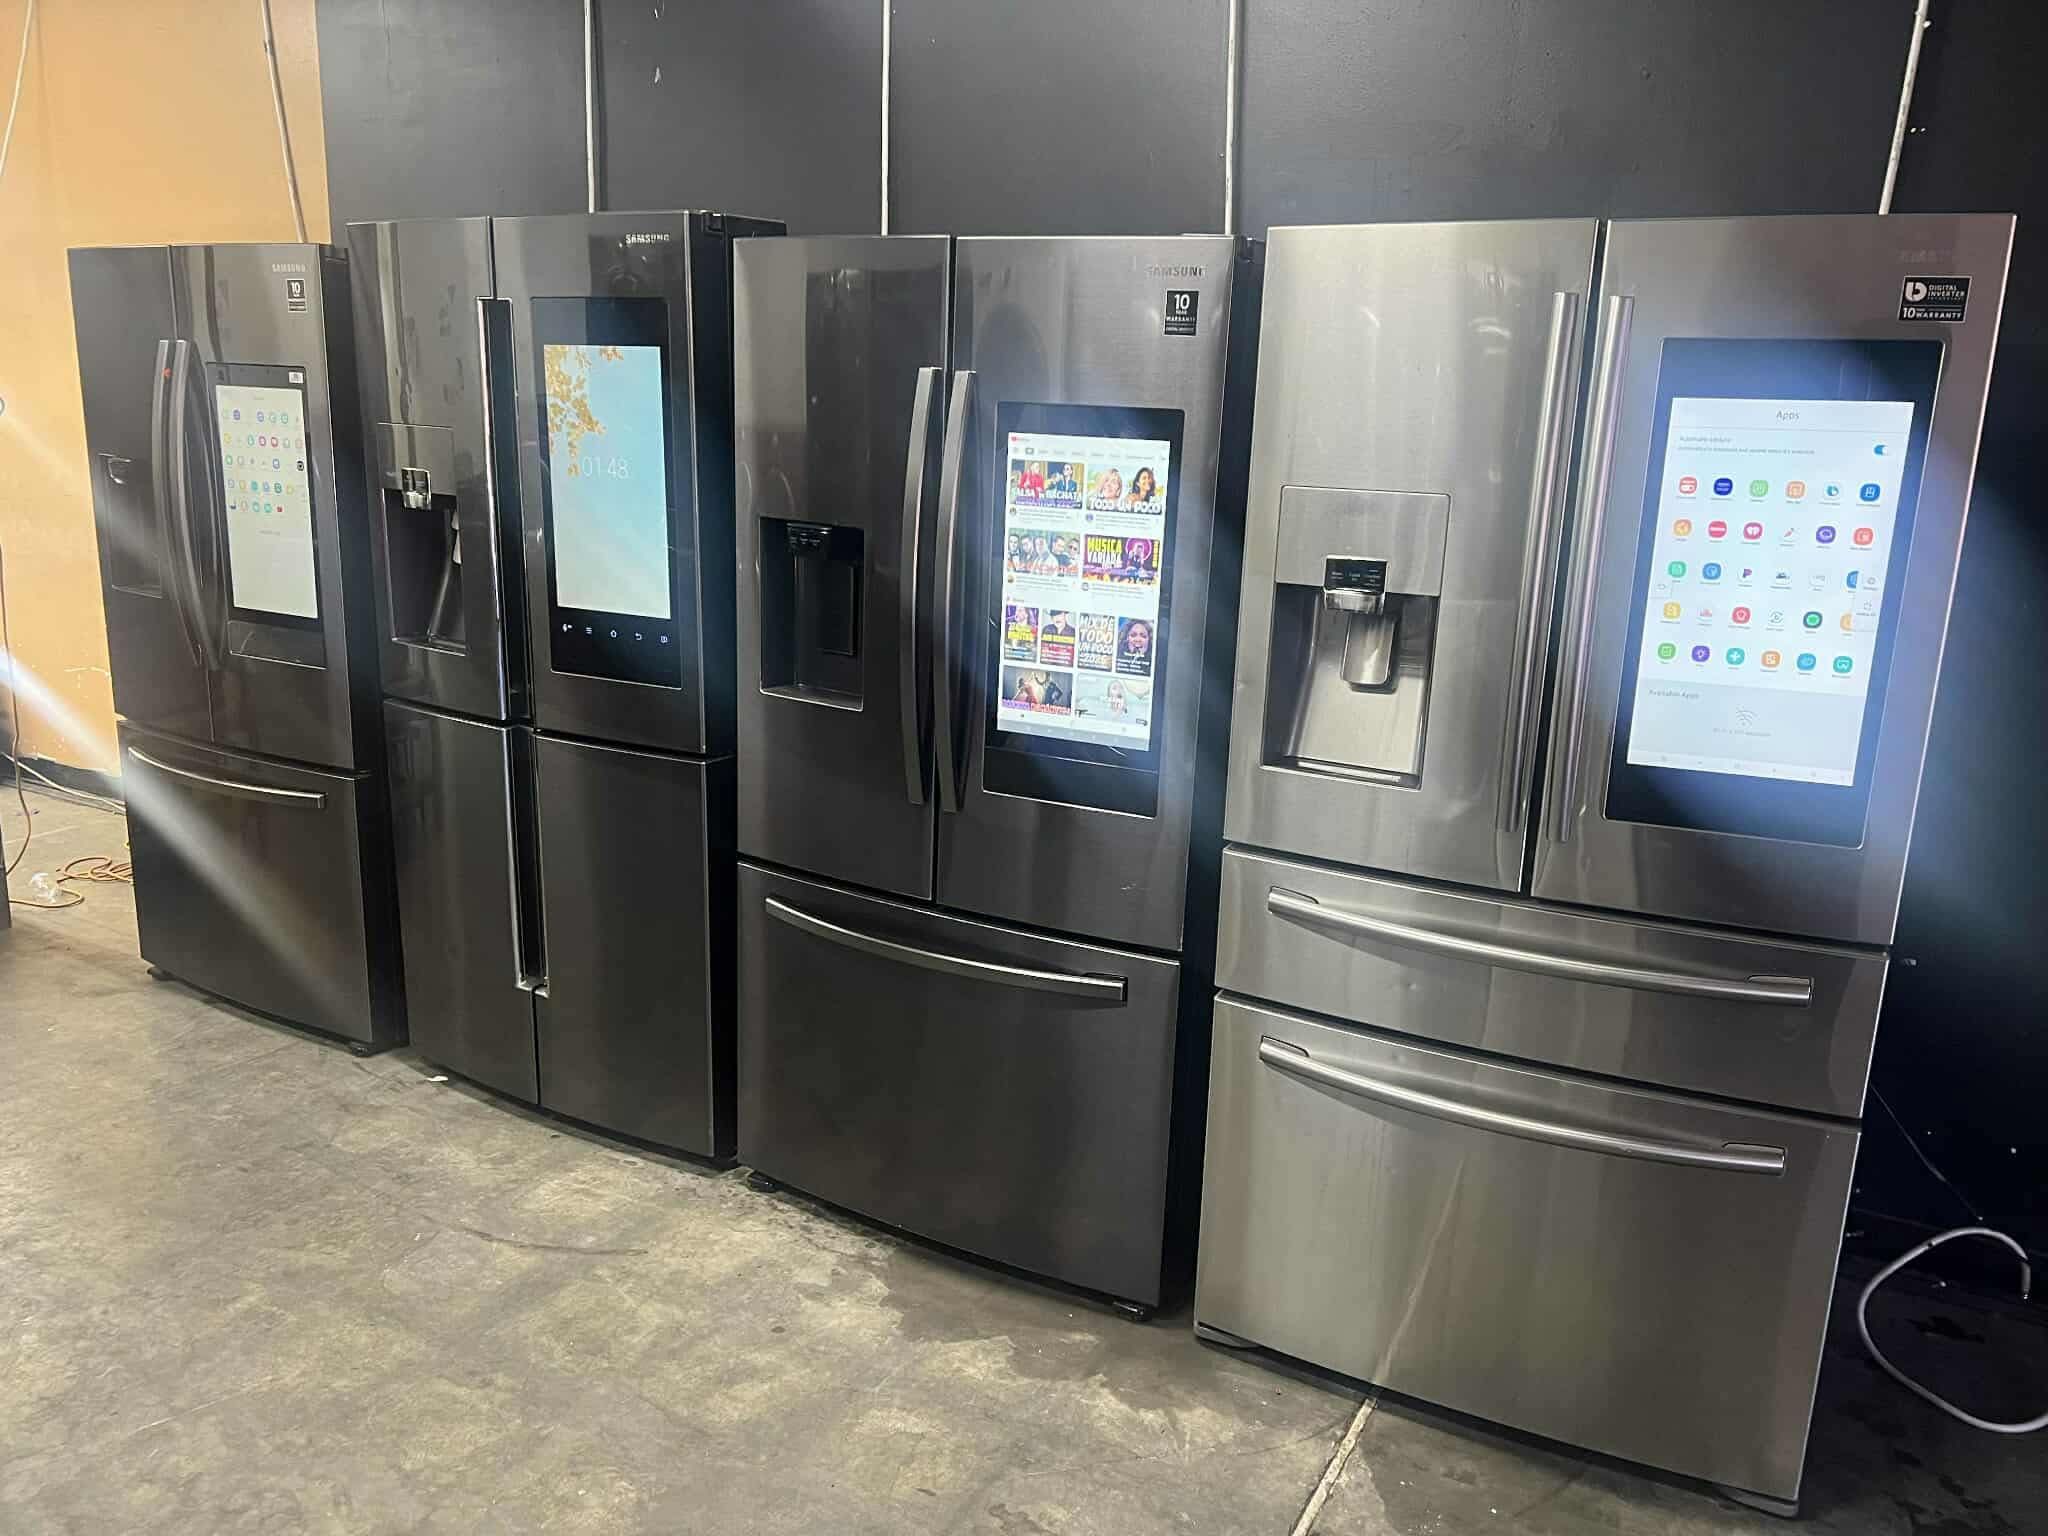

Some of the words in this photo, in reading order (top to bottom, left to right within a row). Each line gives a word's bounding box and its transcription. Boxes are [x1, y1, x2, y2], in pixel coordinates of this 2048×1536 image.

[625, 233, 670, 244] SAMSUNG
[1146, 264, 1207, 278] SAMSUNG
[1927, 290, 1965, 298] INVERTER
[1174, 294, 1190, 310] 10
[1903, 307, 1916, 318] 10
[1776, 409, 1800, 421] Apps
[1087, 536, 1122, 553] MUSICA
[1080, 628, 1113, 645] TODO
